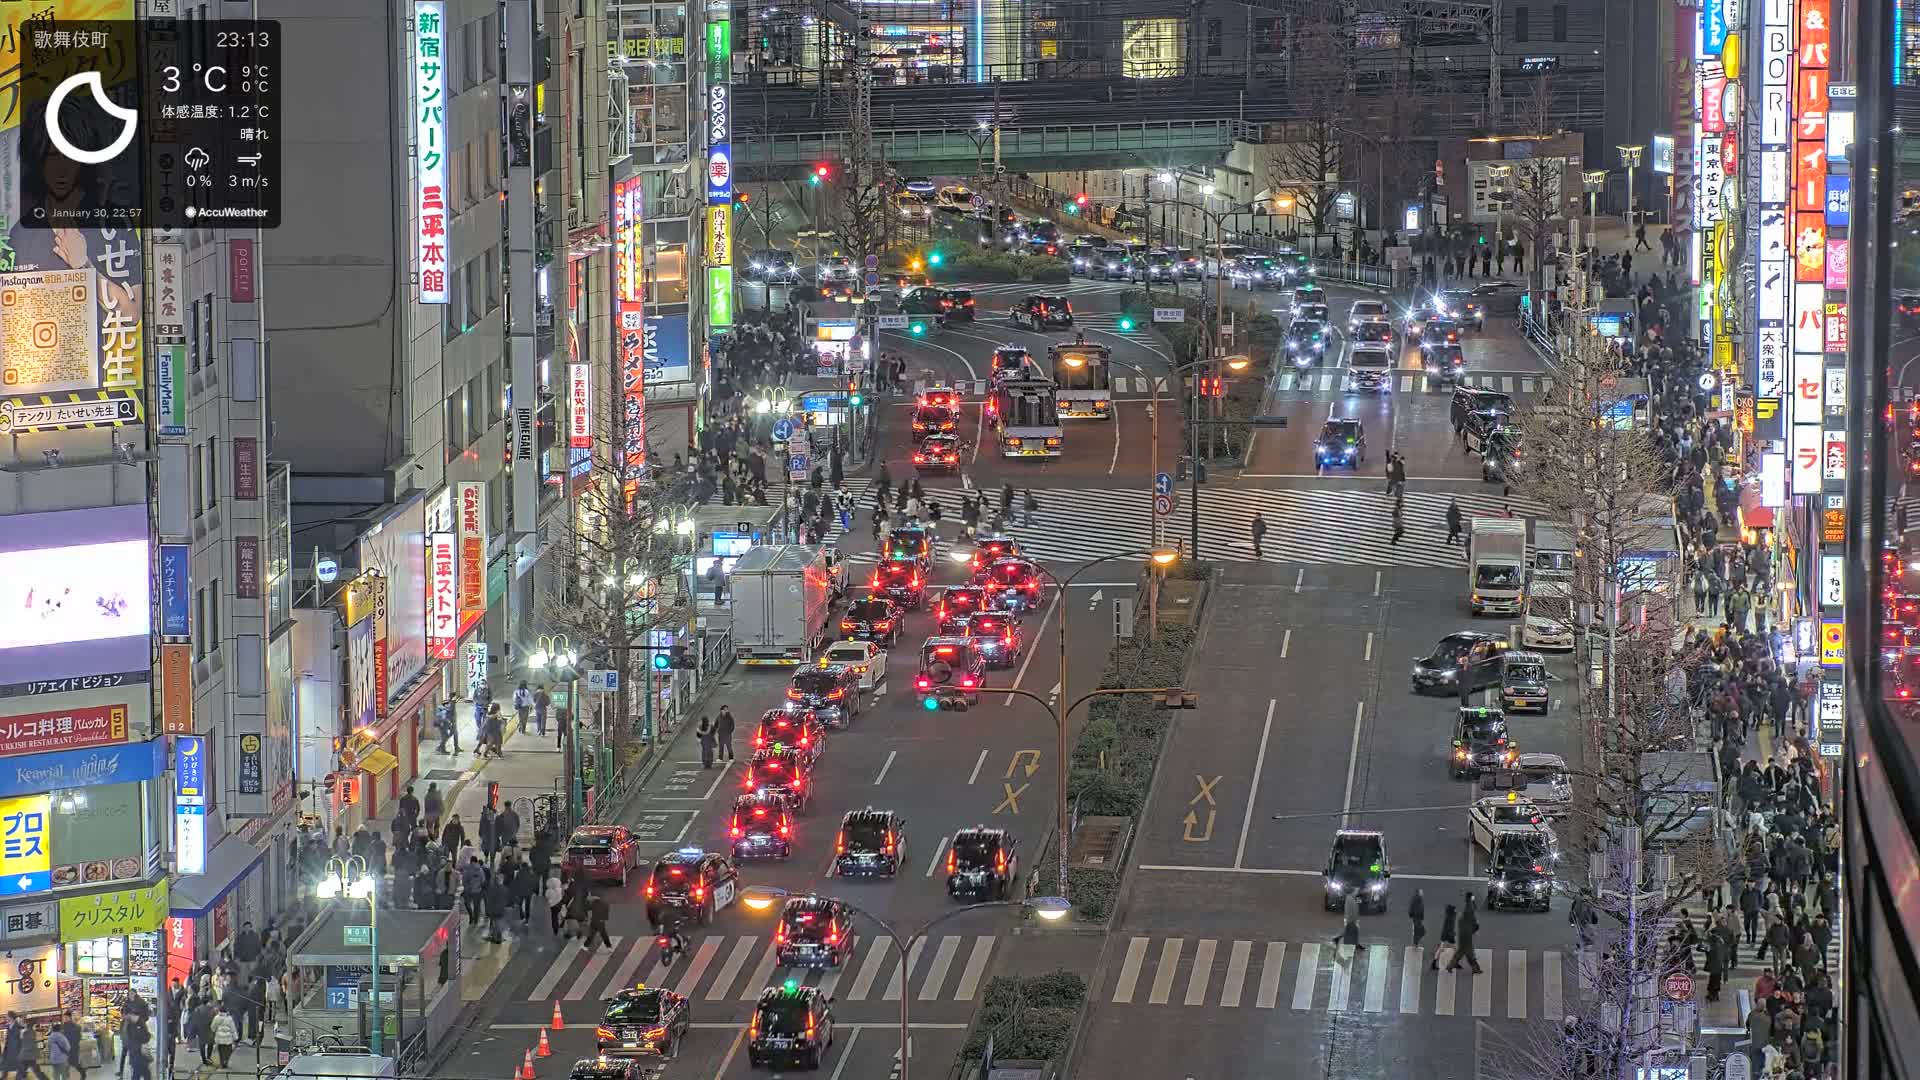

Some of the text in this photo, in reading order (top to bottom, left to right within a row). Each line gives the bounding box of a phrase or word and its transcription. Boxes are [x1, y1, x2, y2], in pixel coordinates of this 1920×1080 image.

[712, 86, 726, 139] もつなべ
[418, 12, 446, 292] 新宿サンパーク 三平本館
[711, 162, 727, 178] 薬
[714, 209, 727, 264] 肉汁水餃子
[0, 276, 44, 289] Instagram
[161, 325, 179, 334] 3F
[623, 332, 641, 388] ラーメン
[1762, 332, 1775, 382] 大衆酒場
[160, 354, 172, 415] FamilyMart
[1798, 308, 1823, 469] パセラ
[57, 408, 115, 420] たいせい先生
[1831, 406, 1844, 414] 5F
[518, 407, 531, 460] HOMEGAME
[464, 488, 474, 531] GAME
[1830, 498, 1841, 507] 3F
[165, 556, 175, 607] ゲウチャイ
[436, 544, 451, 629] 三平ストア
[1830, 578, 1840, 602] ねぎし
[113, 712, 122, 735] 5F
[29, 736, 73, 748] RESTAURANT
[3, 812, 43, 836] プロ
[4, 837, 43, 858] ミス
[8, 912, 42, 932] 囲碁
[73, 904, 144, 927] クリスタル
[330, 992, 345, 1004] 12
